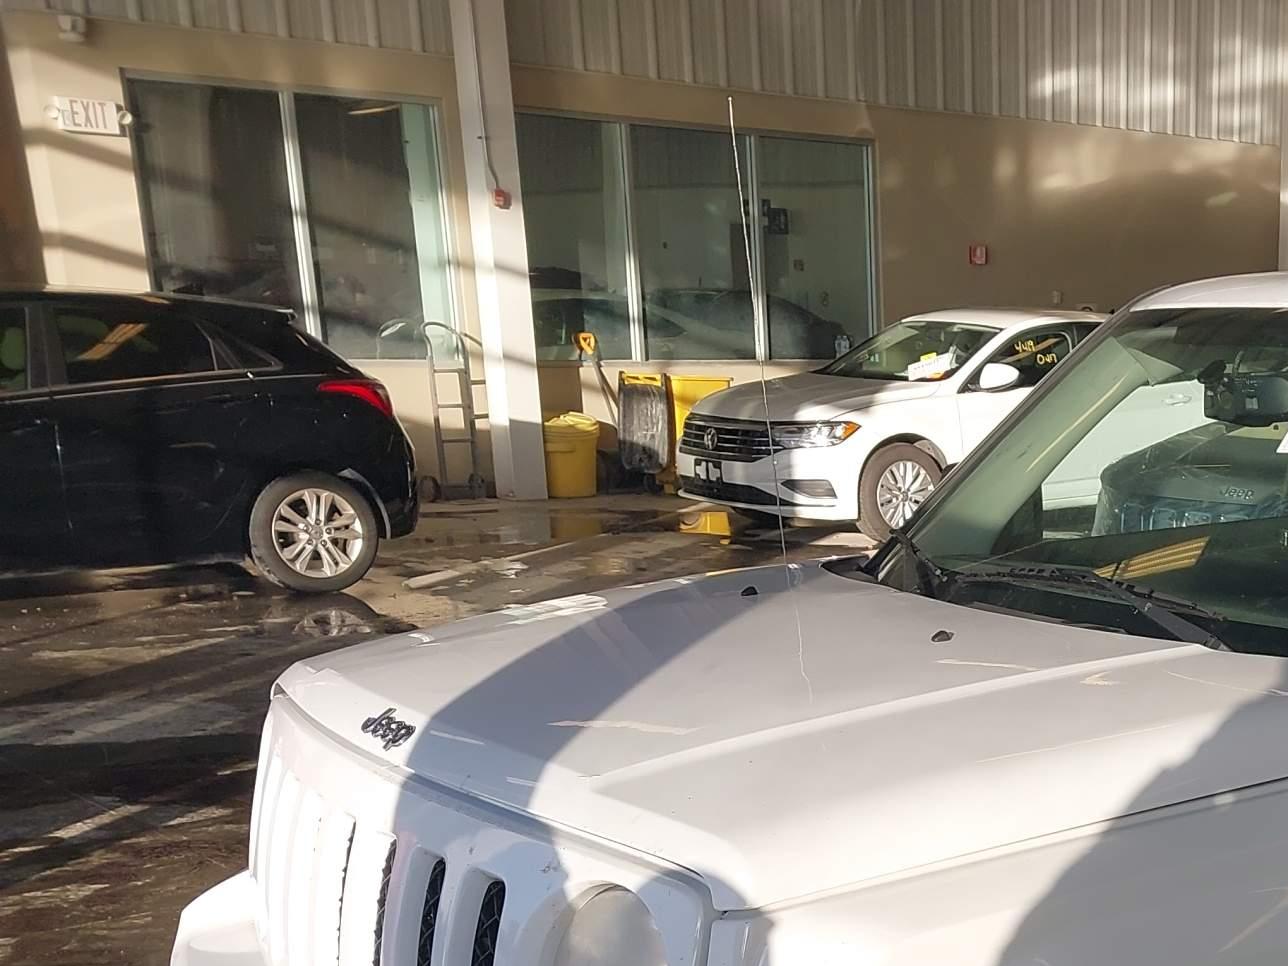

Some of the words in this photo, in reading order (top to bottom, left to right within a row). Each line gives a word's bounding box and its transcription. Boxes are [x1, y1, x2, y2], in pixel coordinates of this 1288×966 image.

[68, 99, 108, 129] EXIT
[1220, 486, 1255, 501] Jeep
[361, 707, 416, 751] Jeep
